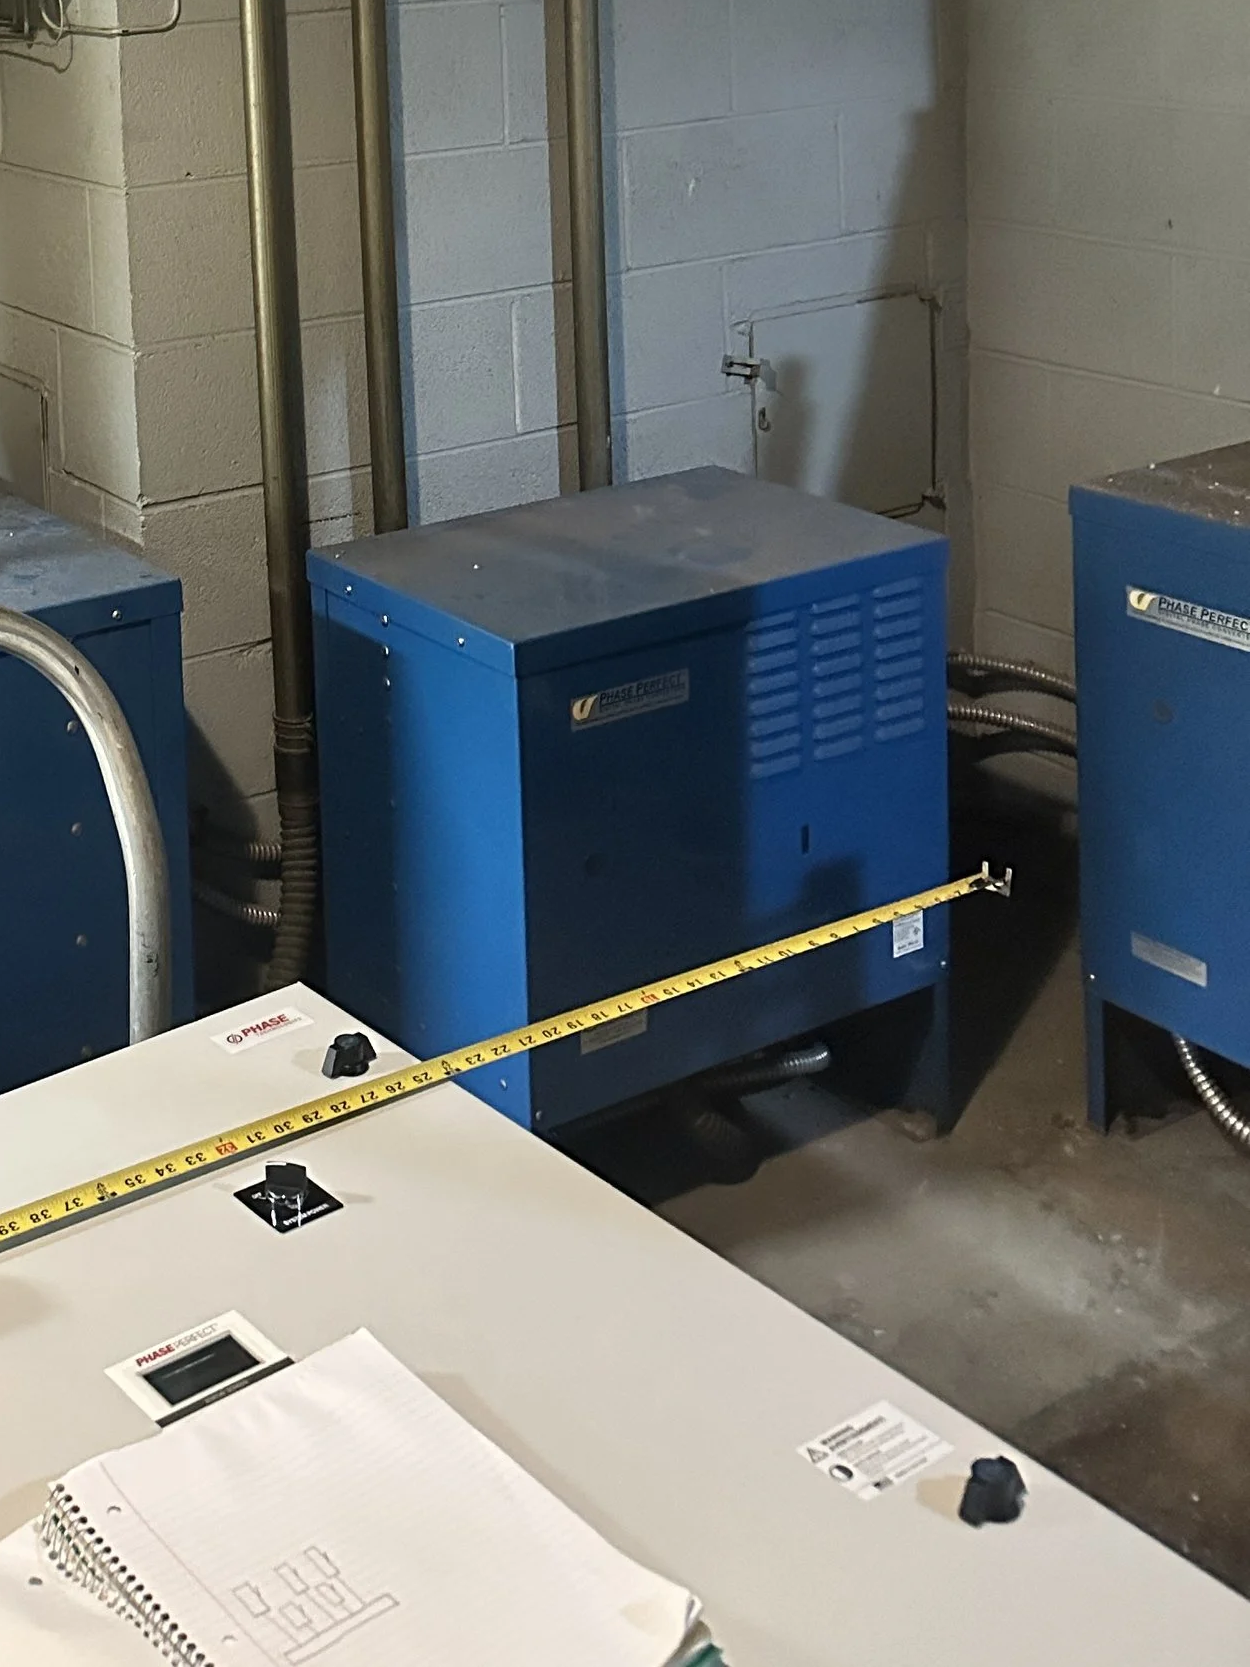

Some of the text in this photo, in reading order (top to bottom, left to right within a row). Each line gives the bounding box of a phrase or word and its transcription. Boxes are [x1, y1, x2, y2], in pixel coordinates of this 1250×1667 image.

[1158, 596, 1250, 631] PHASE PERFEC
[599, 686, 634, 704] PHASE
[636, 675, 682, 694] PERFECT
[756, 955, 774, 964] 11
[709, 970, 726, 980] 13
[686, 978, 704, 988] 14
[662, 986, 680, 996] 15
[616, 1001, 634, 1012] 17
[591, 1010, 609, 1022] 18
[241, 1014, 289, 1037] PHASE
[567, 1018, 585, 1030] 19
[542, 1026, 562, 1039] 20
[518, 1035, 537, 1047] 21
[491, 1044, 511, 1057] 22
[465, 1053, 485, 1066] 23
[412, 1071, 433, 1085] 25
[385, 1081, 406, 1094] 26
[360, 1091, 379, 1104] 27
[330, 1101, 351, 1114] 28
[301, 1110, 323, 1124] 29
[273, 1120, 294, 1134] 30
[246, 1131, 266, 1145] 31
[185, 1152, 207, 1166] 33
[155, 1163, 177, 1177] 34
[124, 1174, 147, 1188] 35
[64, 1197, 84, 1212] 37
[29, 1209, 52, 1224] 38
[135, 1343, 176, 1367] PHASE
